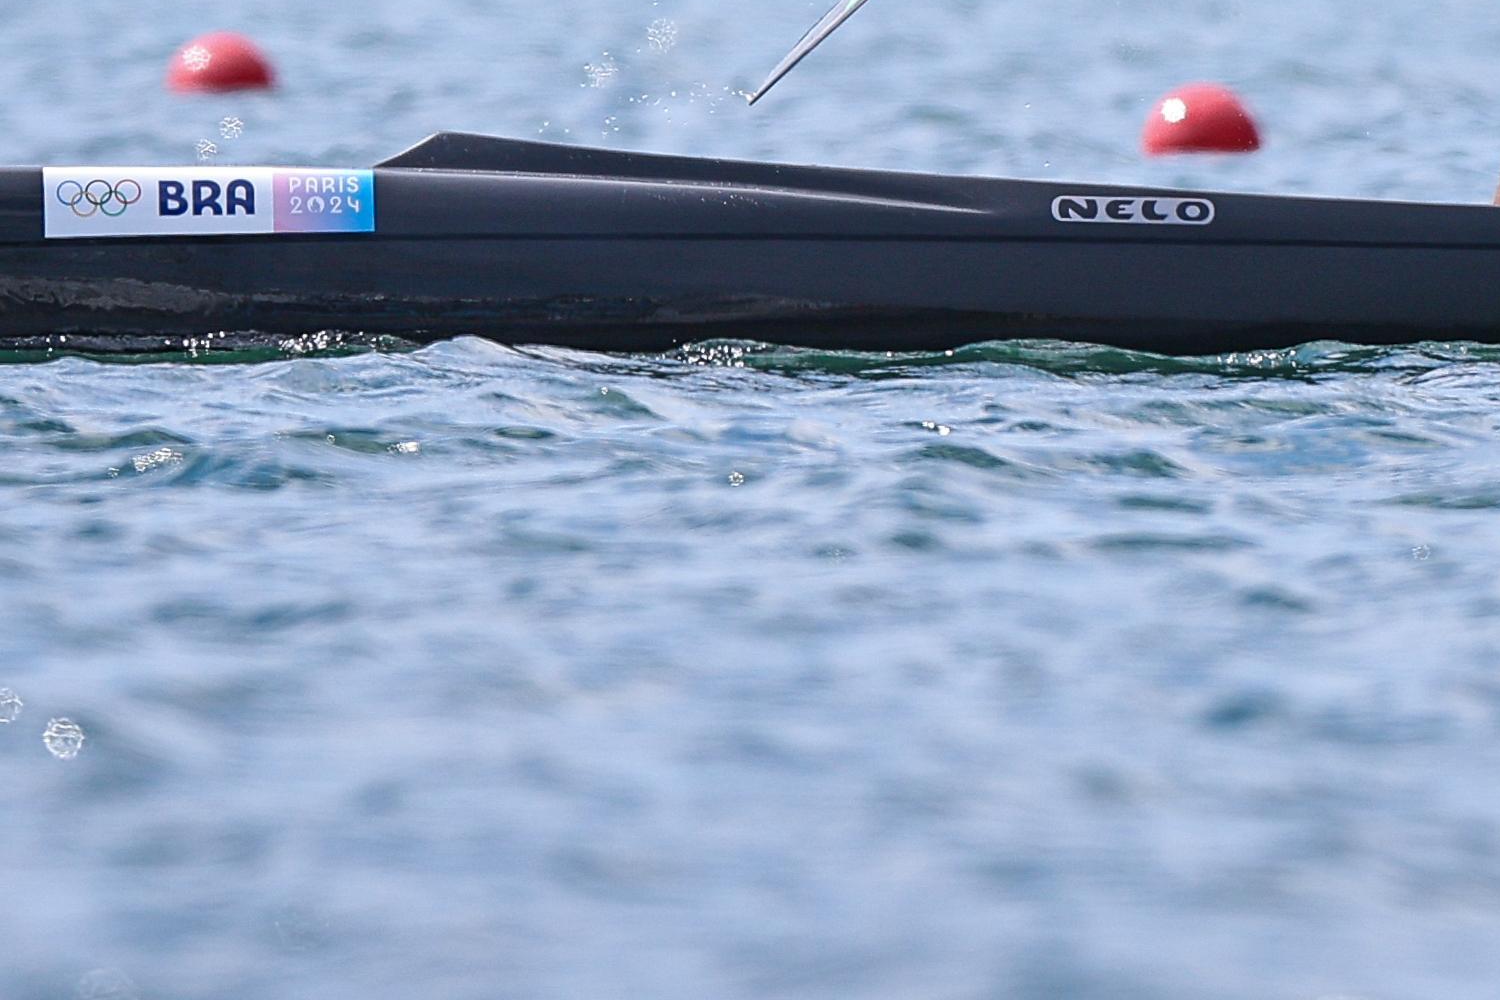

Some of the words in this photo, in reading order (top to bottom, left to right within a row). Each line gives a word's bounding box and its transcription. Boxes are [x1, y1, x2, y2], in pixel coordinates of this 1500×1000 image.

[289, 176, 360, 193] PARIS
[158, 179, 255, 216] BRA
[1058, 198, 1210, 222] NELO
